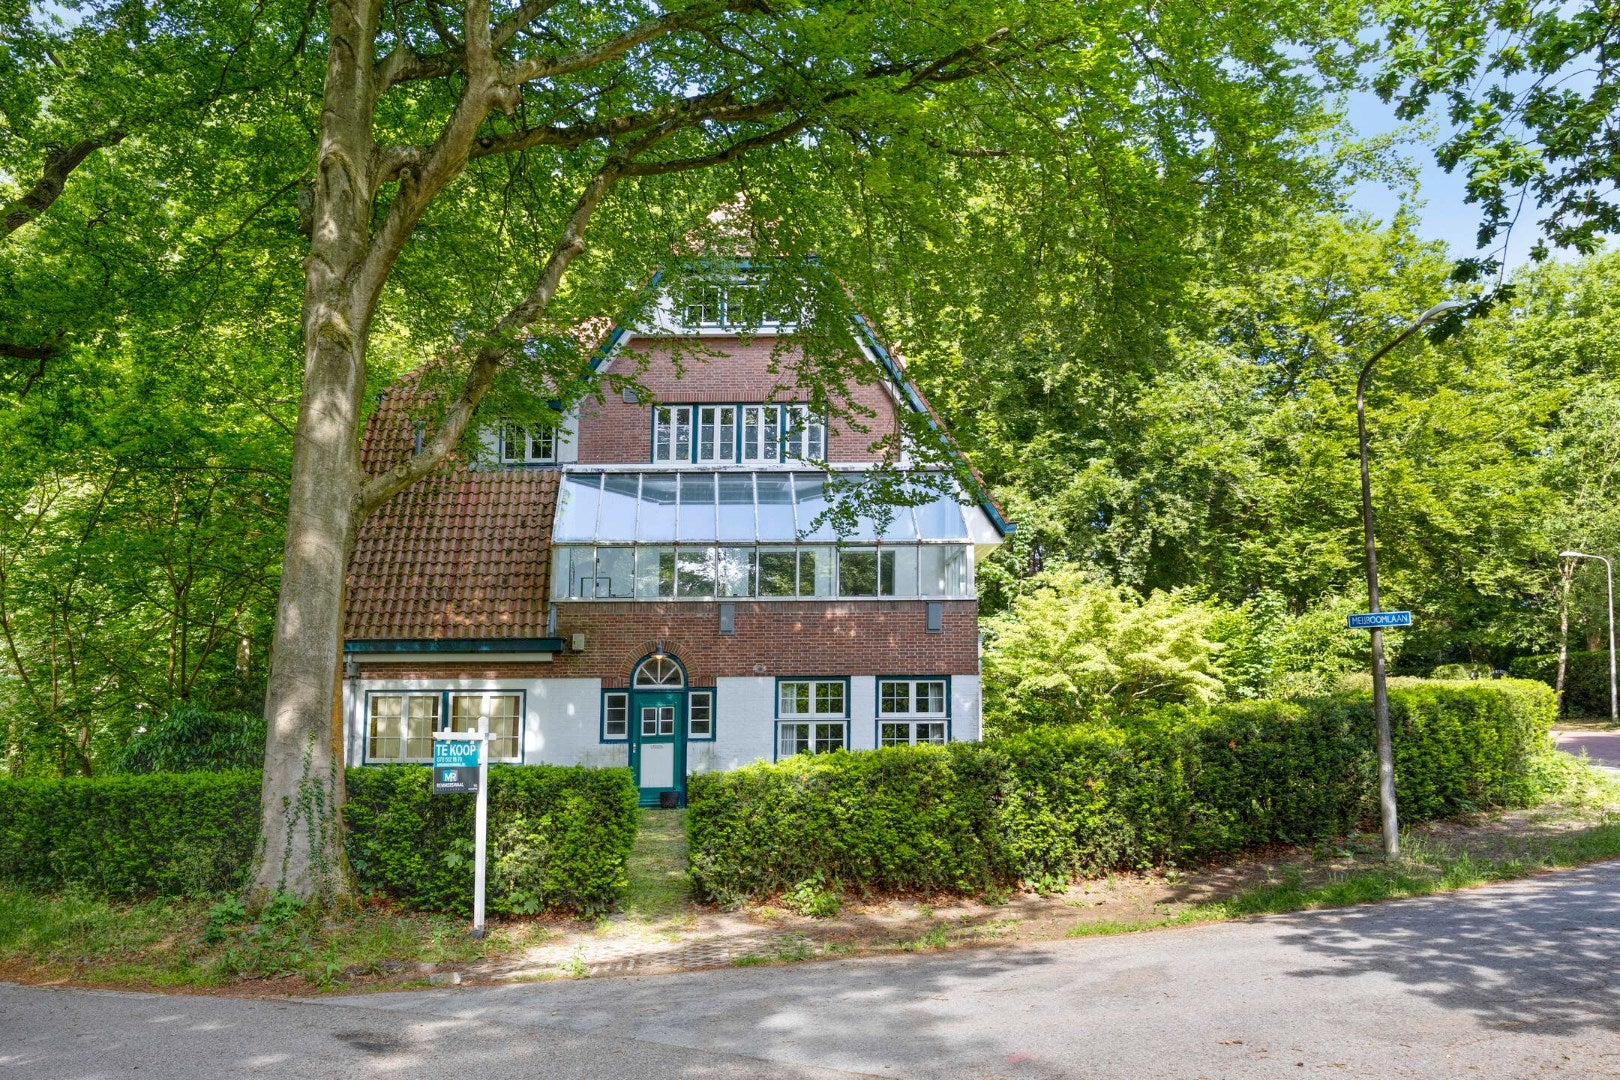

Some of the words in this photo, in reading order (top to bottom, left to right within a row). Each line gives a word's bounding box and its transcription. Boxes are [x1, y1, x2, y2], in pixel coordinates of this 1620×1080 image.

[1351, 614, 1408, 625] MEIJBOOMLAAN
[436, 744, 448, 756] TE
[450, 744, 476, 756] KOOP
[444, 773, 457, 782] MR
